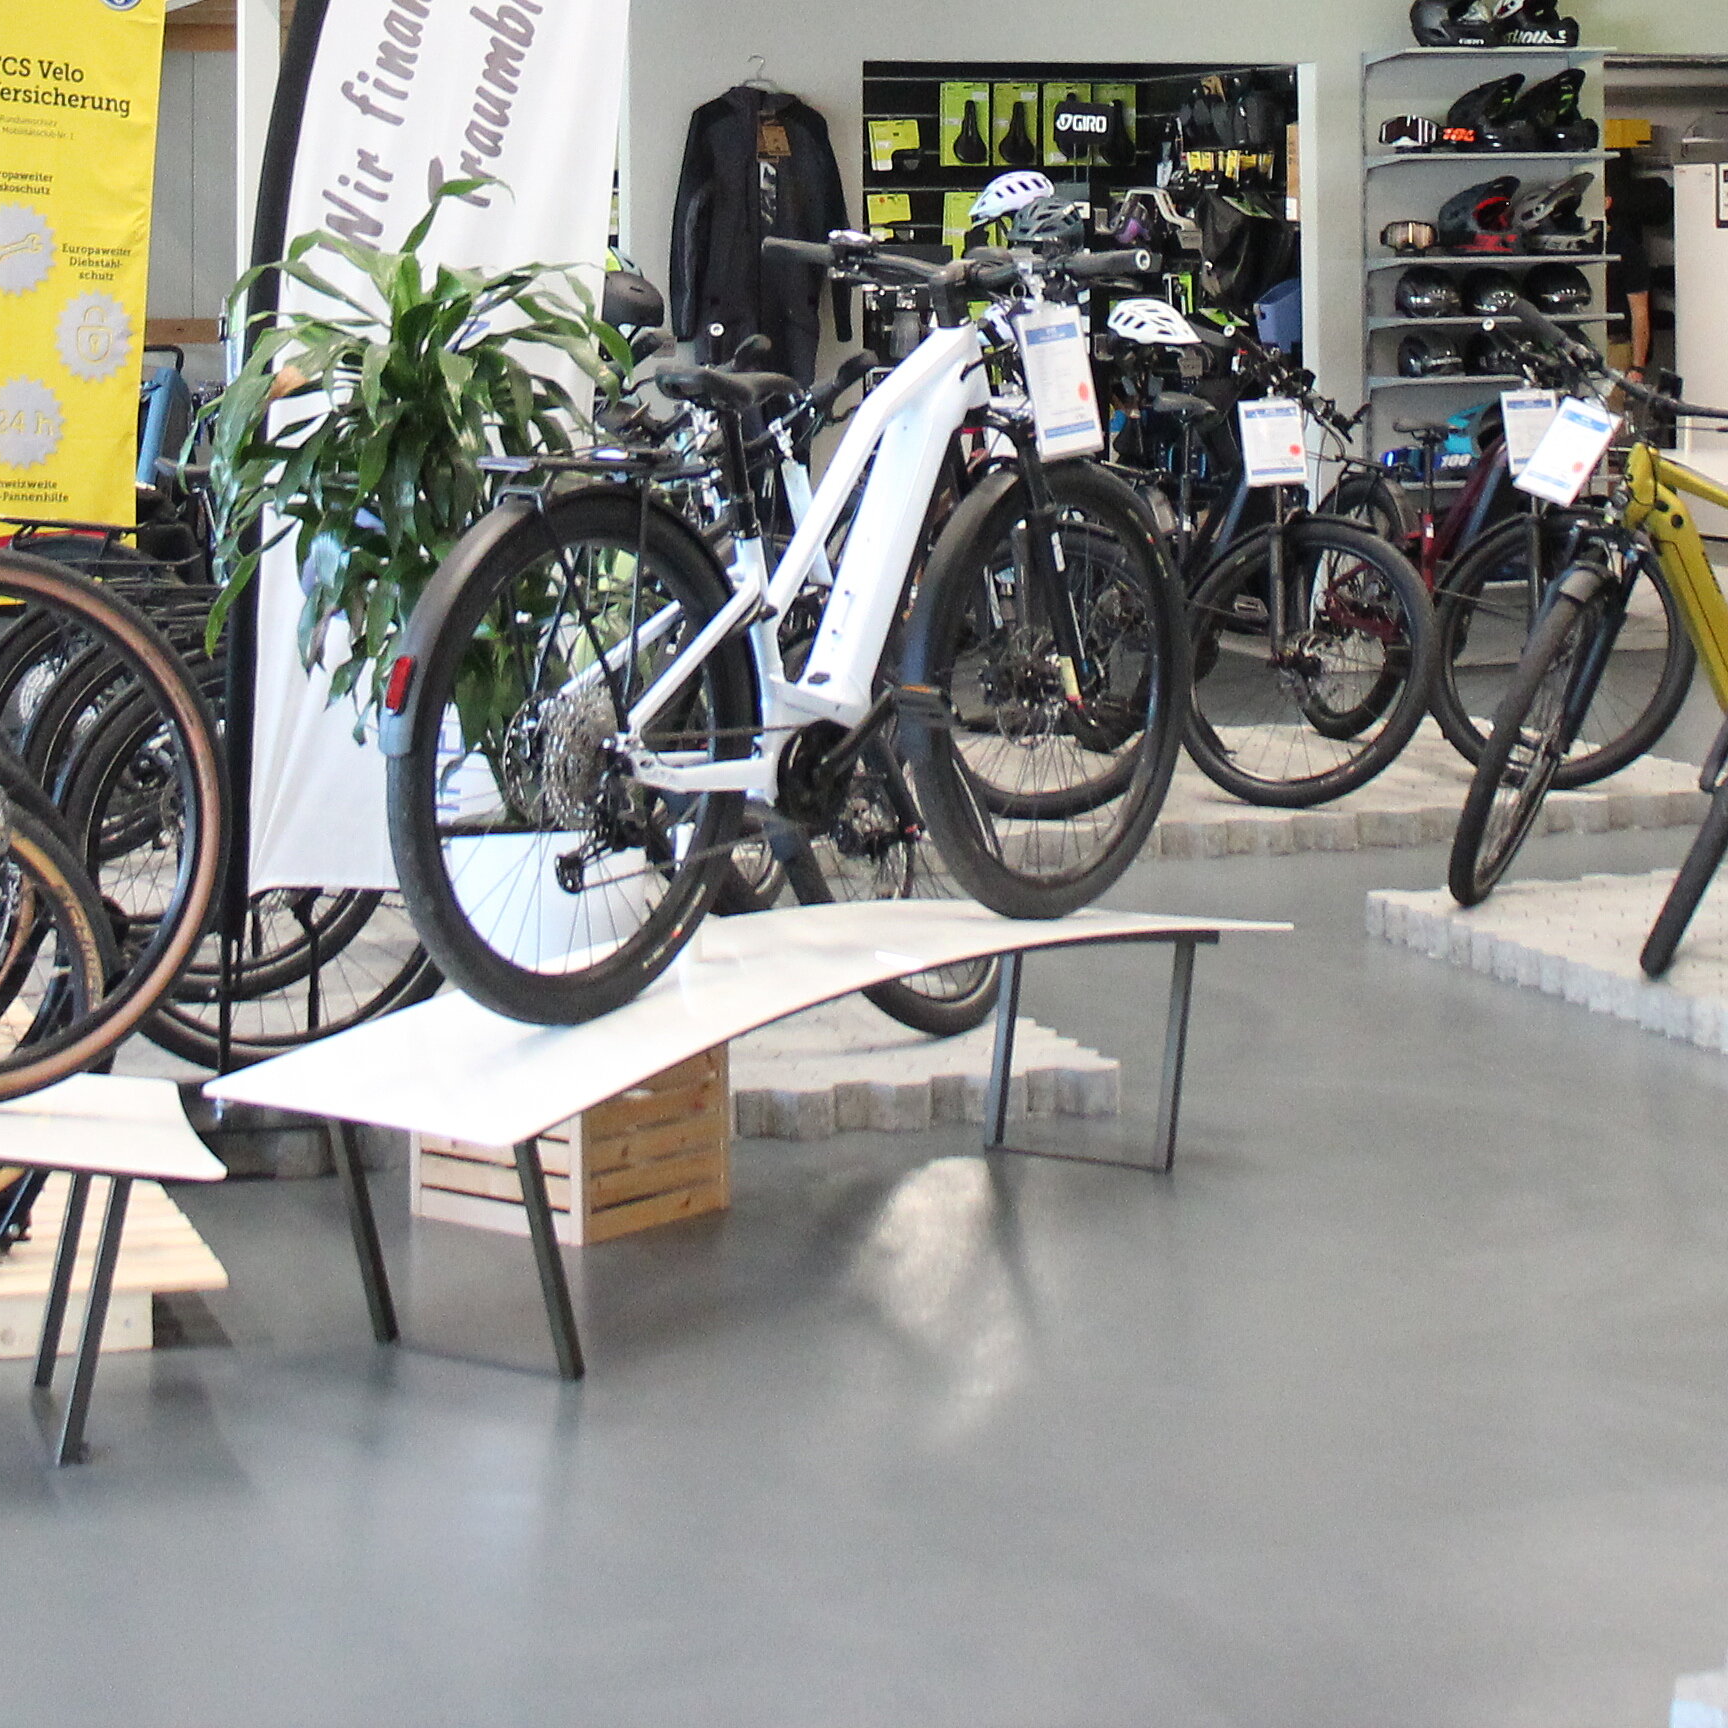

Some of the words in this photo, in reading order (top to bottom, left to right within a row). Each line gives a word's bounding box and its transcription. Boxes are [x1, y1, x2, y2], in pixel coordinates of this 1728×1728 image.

[38, 59, 85, 83] Velo
[1072, 114, 1108, 134] GIRO
[317, 147, 395, 254] Wir
[62, 243, 132, 257] Europaweiter
[69, 256, 124, 269] Diebstahl-
[78, 271, 114, 281] schutz
[34, 410, 54, 436] h
